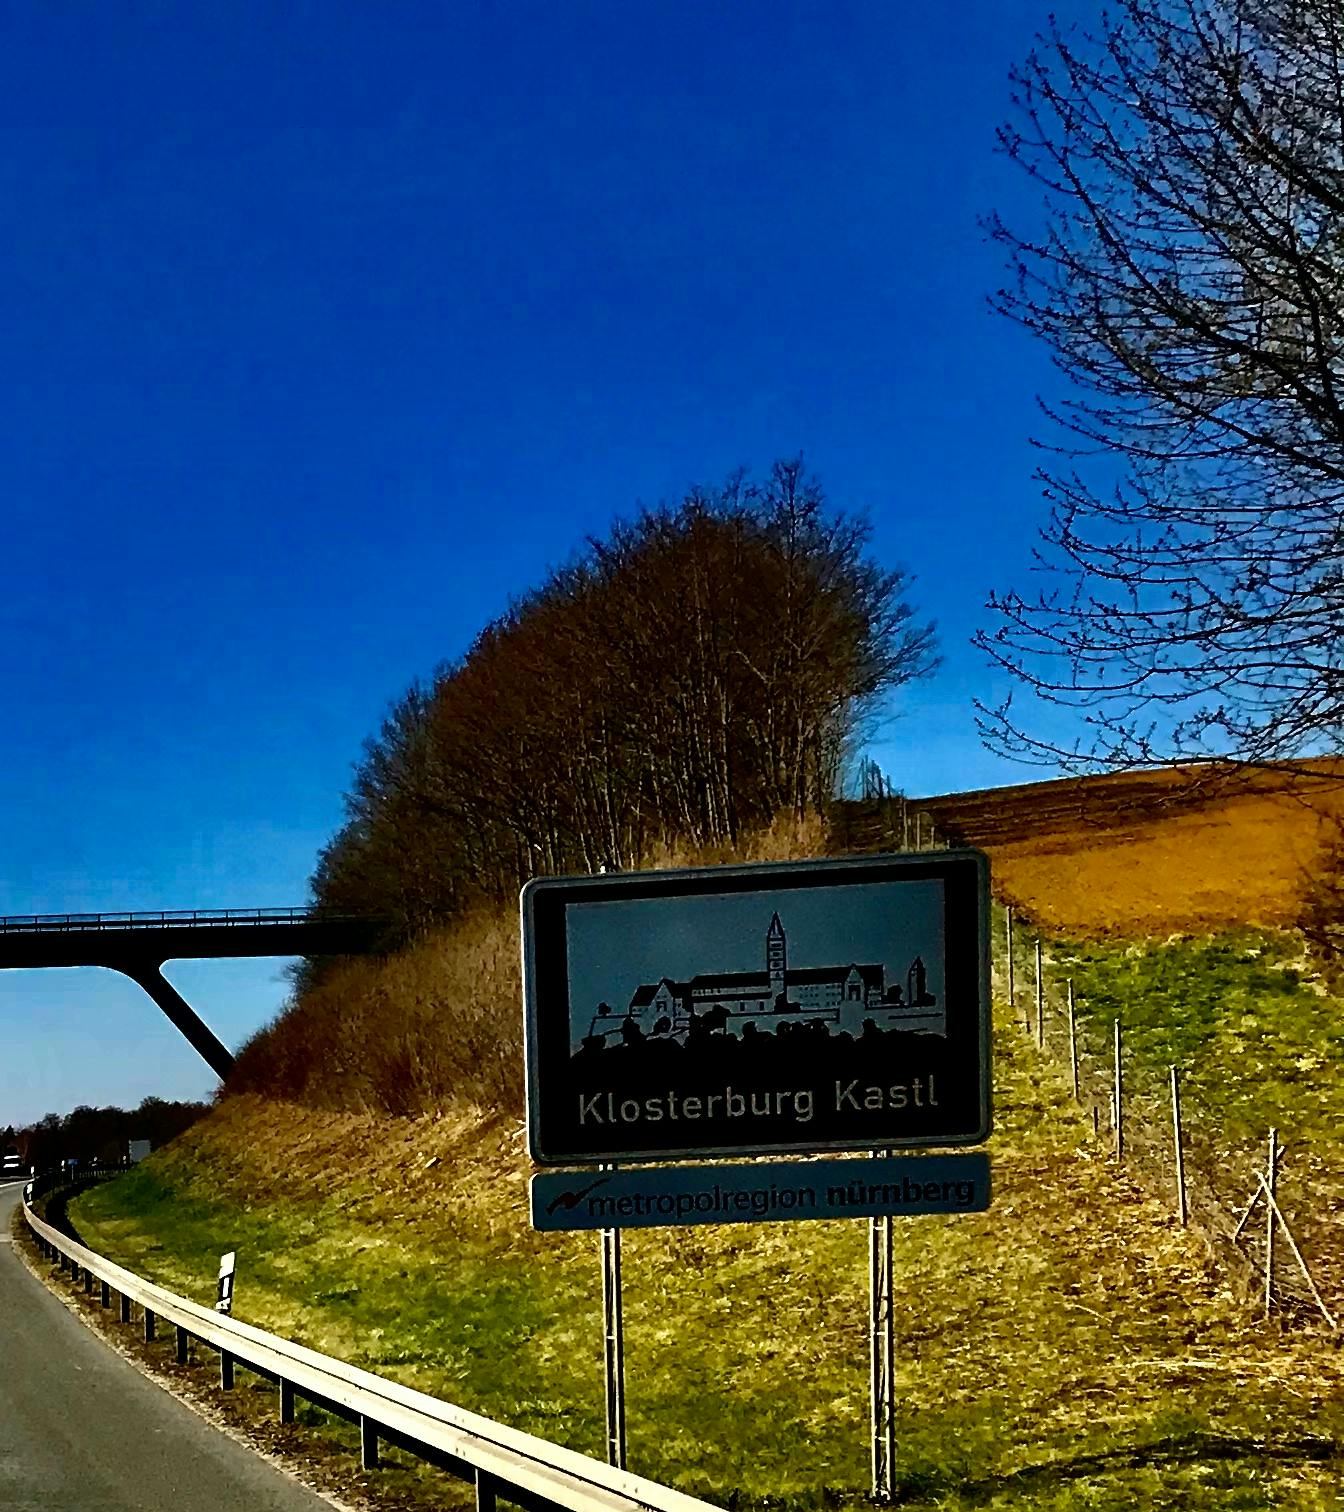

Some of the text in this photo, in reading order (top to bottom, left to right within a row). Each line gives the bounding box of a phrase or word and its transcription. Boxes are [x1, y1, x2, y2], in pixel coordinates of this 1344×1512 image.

[578, 1075, 939, 1124] Klosterburg Kastl
[588, 1176, 975, 1218] metropolregion nürnberg
